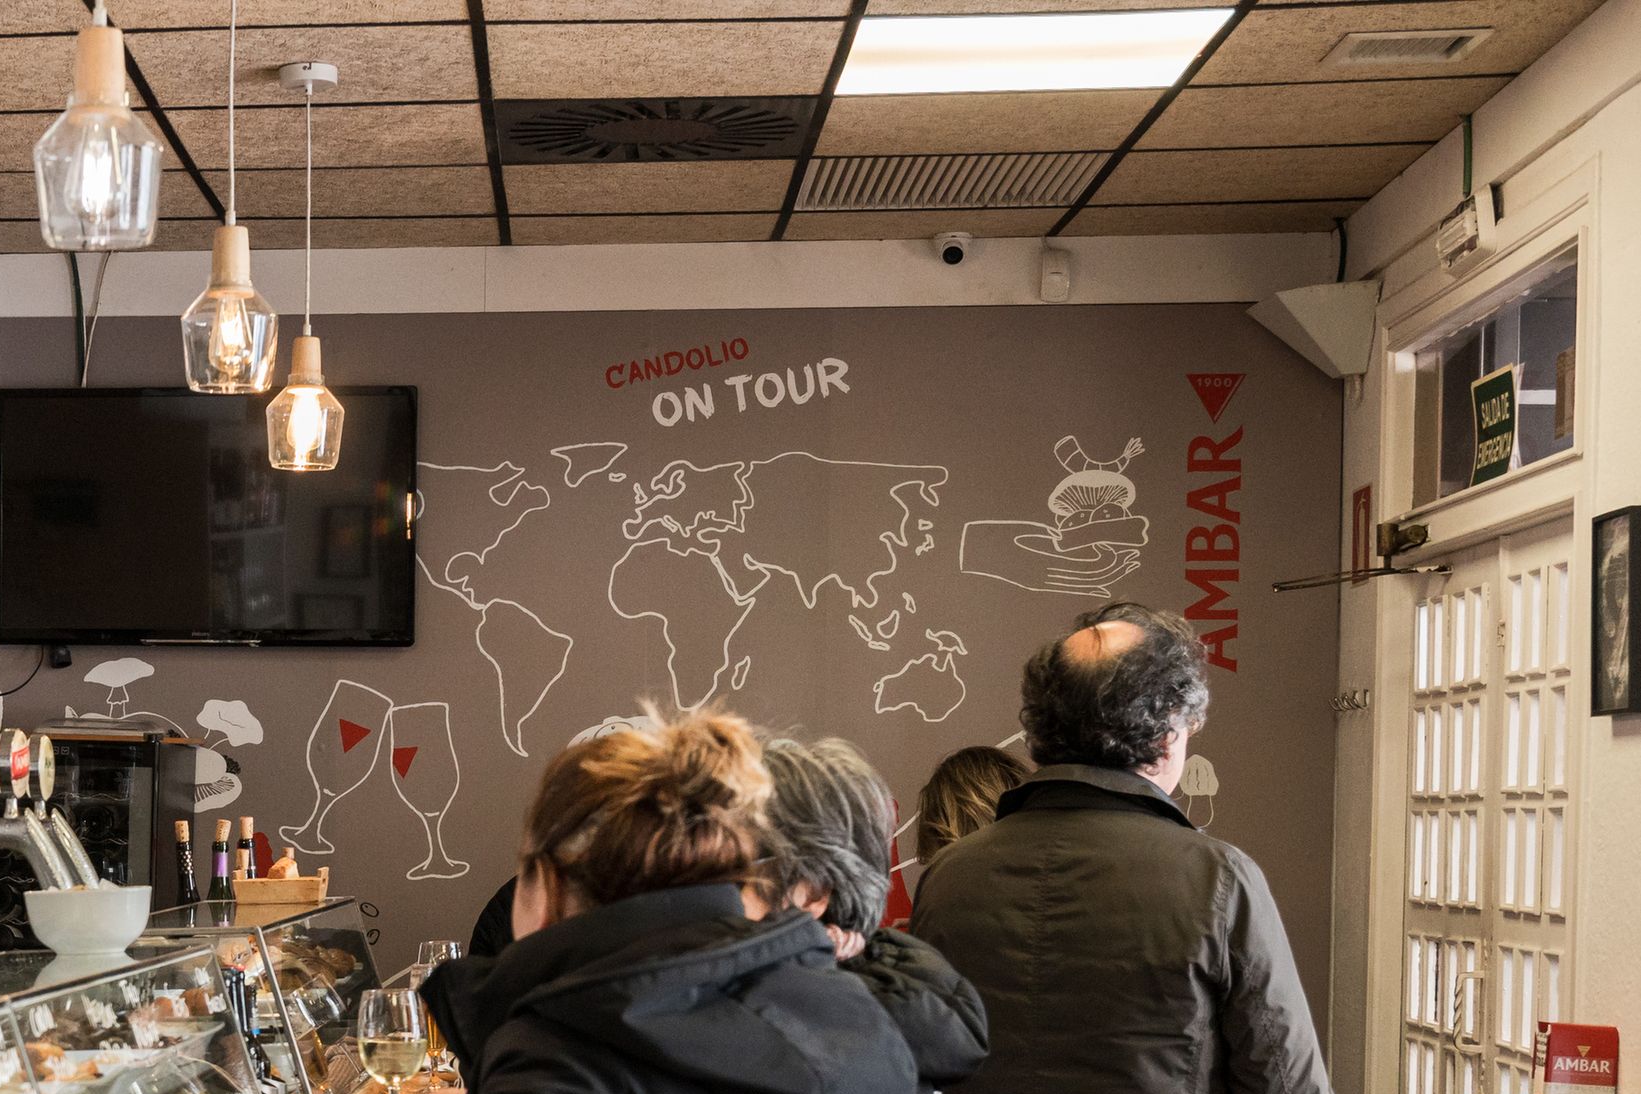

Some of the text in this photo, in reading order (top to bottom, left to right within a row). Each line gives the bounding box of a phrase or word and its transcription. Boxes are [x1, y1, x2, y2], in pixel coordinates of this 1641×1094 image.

[605, 337, 749, 389] CANDOLIO
[1196, 376, 1233, 388] 1900
[652, 357, 851, 427] ON TOUR
[1184, 425, 1243, 673] AMBAR
[1554, 1056, 1611, 1074] AMBAR
